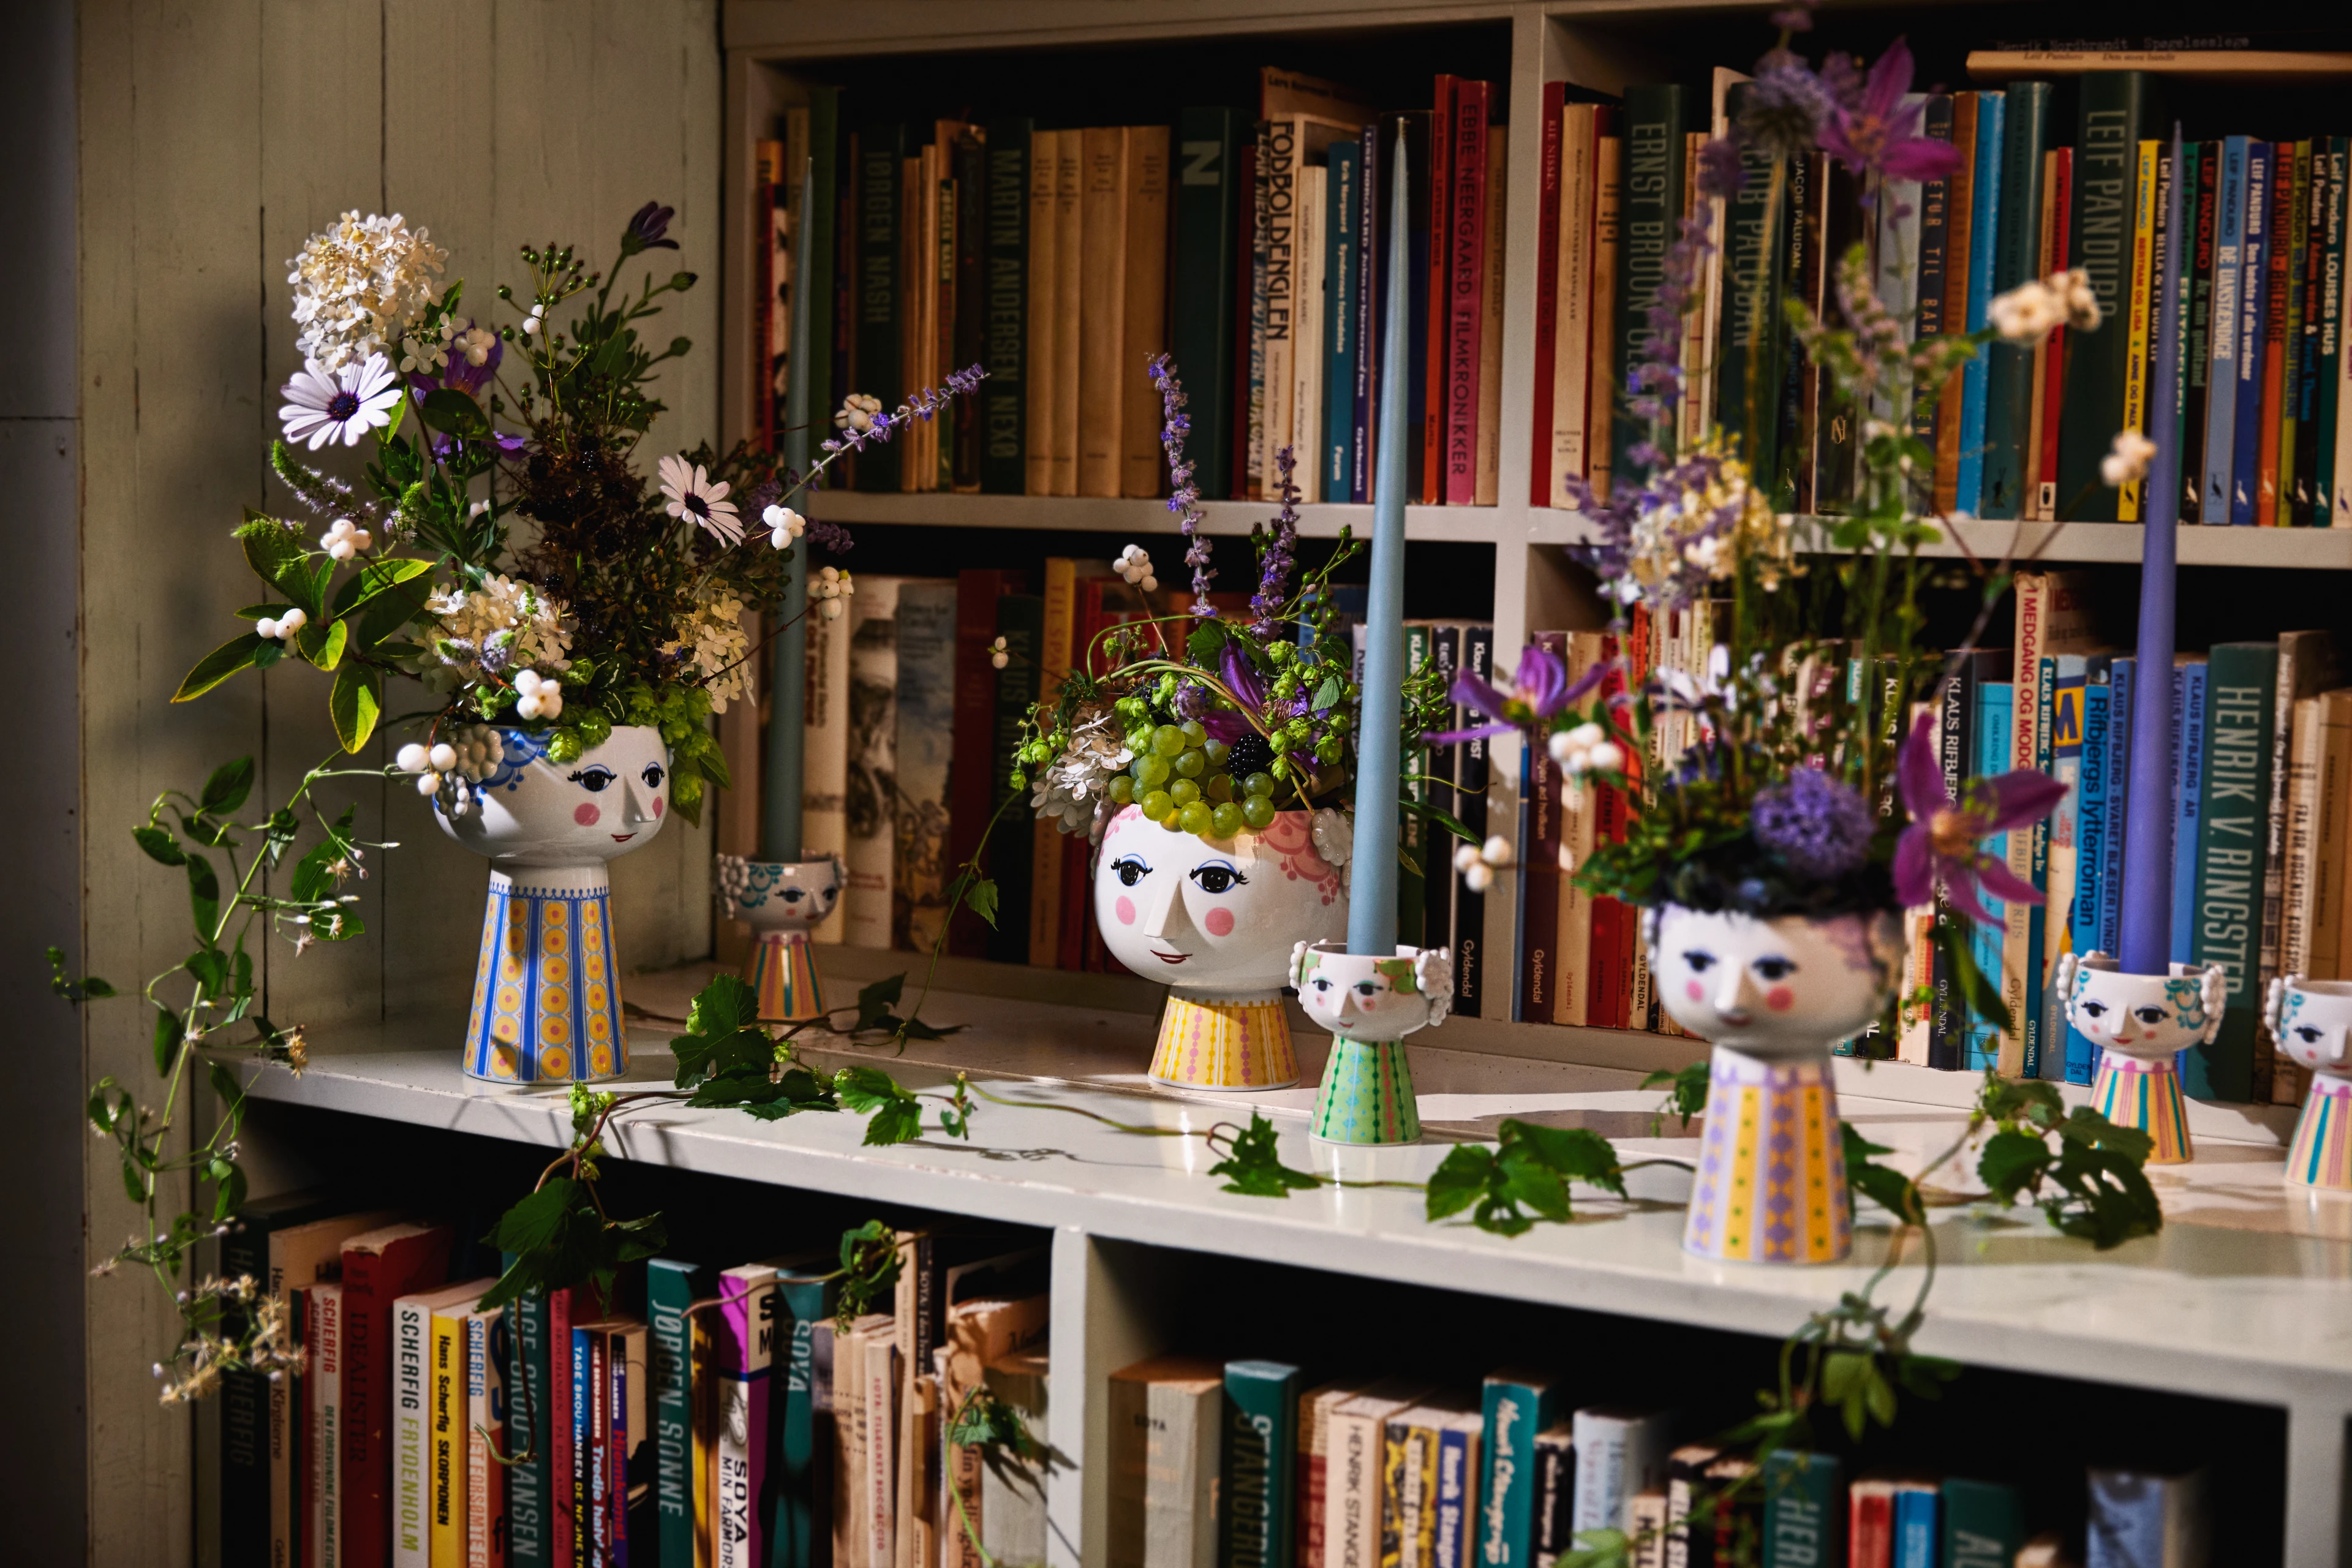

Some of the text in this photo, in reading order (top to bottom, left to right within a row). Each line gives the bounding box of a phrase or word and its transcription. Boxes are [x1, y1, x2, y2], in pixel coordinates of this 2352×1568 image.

[2013, 135, 2025, 198] PALUDAN
[2084, 110, 2127, 168] LEIF
[2182, 155, 2196, 188] Leif
[2250, 158, 2264, 180] LEIF
[1362, 168, 1371, 248] NØRGAARD
[1627, 122, 1667, 312] ERNST BRUUN
[1793, 160, 1806, 205] JACOB
[2155, 157, 2172, 228] Leif Panduro
[2247, 183, 2263, 235] PANDURO
[2271, 154, 2291, 257] LEIF PANDURO
[2292, 156, 2309, 244] Leif Panduro
[1266, 122, 1294, 341] FODBOLDENGLEN
[1540, 144, 1556, 349] NISSEN OM MENNESKER OG MIG
[1791, 209, 1805, 269] PALUDAN
[2010, 206, 2021, 244] SIDEN
[2213, 152, 2239, 360] LEIF PANDURO DE UANSTÆNDIGE
[2246, 243, 2260, 263] Den
[2321, 153, 2345, 357] Leif Panduro LOUISES HUS
[864, 255, 891, 324] NASH
[1452, 105, 1477, 474] EBBE FILMKRONIKKER
[1733, 219, 1772, 347] PALUDAN
[1923, 247, 1941, 277] TIL
[2128, 155, 2149, 427] LEIF PANDURO BERTRAM OG LISA ANNE OG PAUL
[2190, 157, 2215, 388] LEIF PANDURO min guldtand
[2244, 265, 2259, 300] bedste
[2300, 154, 2327, 421] Leif Panduro Adams verden & Thomas
[989, 149, 1022, 459] MARTIN ANDERSEN NEXØ
[1333, 159, 1351, 481] Erik Nørgaard Syndernes forladelse Forum
[2241, 336, 2255, 381] verdener
[1786, 388, 1798, 429] FYRET
[1049, 583, 1066, 615] TIL
[1000, 629, 1030, 703] KLAUS
[1471, 642, 1485, 673] Klaus
[2021, 595, 2037, 683] MEDGANG
[2018, 688, 2034, 715] OG
[2039, 666, 2053, 763] KLAUS RIFBJERG
[2113, 673, 2125, 717] KLAUS
[1944, 676, 1961, 807] KLAUS RIFBJERG
[2110, 722, 2124, 785] RIFBJERG
[2185, 676, 2203, 790] KLAUS RIFBJERG
[2207, 686, 2262, 837] HENRIK V.
[1536, 786, 1549, 840] ad hvilken
[2079, 696, 2109, 927] Rifbjergs lytterroman
[2108, 796, 2122, 848] SVARET
[2295, 804, 2309, 823] FRA
[2035, 859, 2046, 873] liv
[2105, 850, 2119, 912] BLÆSER
[1460, 939, 1474, 998] Gyldendal
[1531, 949, 1545, 1004] Gyldendal
[1565, 972, 1575, 1011] Gyldendal
[1620, 957, 1629, 996] GYLDENDAL
[1637, 954, 1648, 1012] GYLDENDAL
[1937, 979, 1948, 1037] GYLDENDAL
[2007, 978, 2021, 1041] Gyldendal
[2026, 1019, 2037, 1068] GYLDENDAL
[2048, 1005, 2057, 1054] GYLDENDAL
[2066, 1061, 2092, 1071] GYLDEN
[349, 1311, 368, 1463] IDEALISTER
[468, 1320, 485, 1397] SCHERFIG
[780, 1318, 812, 1392] SOYA
[271, 1388, 285, 1460] Kirgiserne
[323, 1297, 336, 1496] SCHERFIG DEN FORSVUNDNE
[400, 1310, 420, 1553] SCHERFIG FRYDENHOLM
[437, 1335, 451, 1526] Hans Scherfig SKORPIONEN
[554, 1291, 566, 1552] TAGE SKOU-HANSEN PÅ DEN SIDE
[573, 1346, 584, 1501] TAGE SKOU-HANSEN DE
[592, 1366, 601, 1439] SKOU-HANSEN
[651, 1299, 684, 1519] JØRGEN SONNE
[470, 1430, 484, 1461] DET
[509, 1360, 539, 1558] SKOU-HANSEN
[590, 1445, 605, 1501] Tredje
[611, 1349, 627, 1540] SKOU-HANSEN Hjemkomst
[722, 1457, 733, 1488] MIN
[1348, 1412, 1363, 1493] HENRIK
[470, 1464, 484, 1546] FORSØMTE
[734, 1460, 747, 1544] SOYA
[874, 1415, 886, 1551] TILEGNET BOCCACCIO
